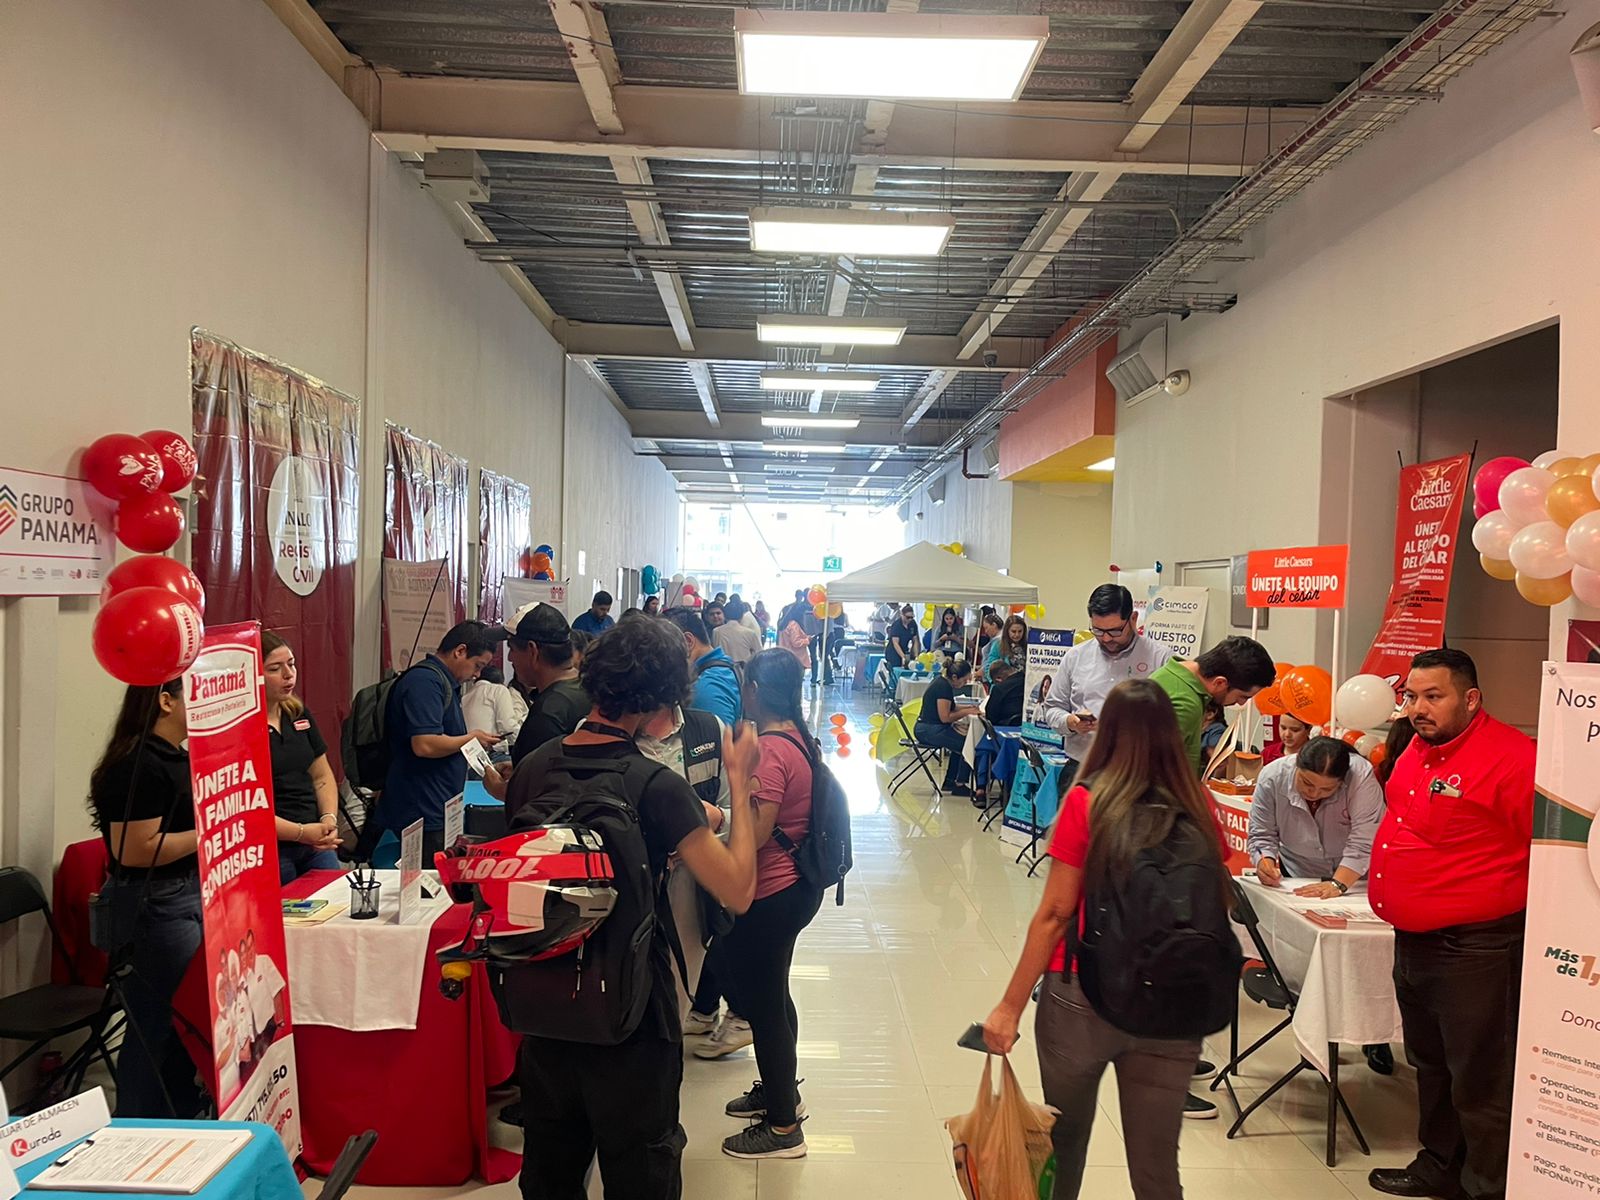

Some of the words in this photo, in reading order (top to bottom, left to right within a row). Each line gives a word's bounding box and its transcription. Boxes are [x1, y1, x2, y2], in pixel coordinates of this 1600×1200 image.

[1416, 478, 1451, 497] Little
[21, 493, 74, 516] GRUPO
[1415, 520, 1441, 537] ÚNET
[1404, 541, 1416, 554] AL
[1403, 556, 1420, 569] DEL
[293, 565, 314, 583] Cvil
[1252, 573, 1282, 592] ÚNETE
[1284, 577, 1298, 591] AL
[1299, 575, 1338, 594] EQUIPO
[1267, 588, 1286, 604] del
[1147, 631, 1196, 644] NUESTRO
[1030, 656, 1040, 664] CON
[1041, 657, 1061, 666] NOSOTR
[1044, 649, 1067, 658] TRABAJA
[190, 662, 246, 702] Panamá
[1556, 687, 1597, 709] Nos
[241, 759, 258, 783] A
[204, 787, 270, 831] FAMILIA
[1227, 812, 1250, 833] FALT
[203, 831, 223, 865] DE
[224, 819, 246, 851] LAS
[202, 844, 265, 907] SONRISAS!
[457, 857, 543, 880] 100%
[1544, 946, 1580, 964] Más
[1556, 963, 1579, 977] de
[1542, 1047, 1582, 1065] Remesas
[1584, 1060, 1600, 1071] Inte
[1540, 1076, 1596, 1099] Operaciones
[1539, 1088, 1551, 1096] de
[1554, 1090, 1564, 1099] 10
[1567, 1094, 1598, 1110] bancos
[23, 1114, 37, 1129] DE
[38, 1099, 79, 1122] ALMACEN
[12, 1127, 62, 1156] Kuroda
[1537, 1120, 1567, 1136] Tarjeta
[1569, 1130, 1600, 1147] Financ
[1546, 1133, 1588, 1153] Bienestar
[1534, 1155, 1557, 1168] Pago
[1560, 1164, 1571, 1173] de
[1533, 1165, 1585, 1188] INFONAVIT
[1587, 1183, 1594, 1192] Y
